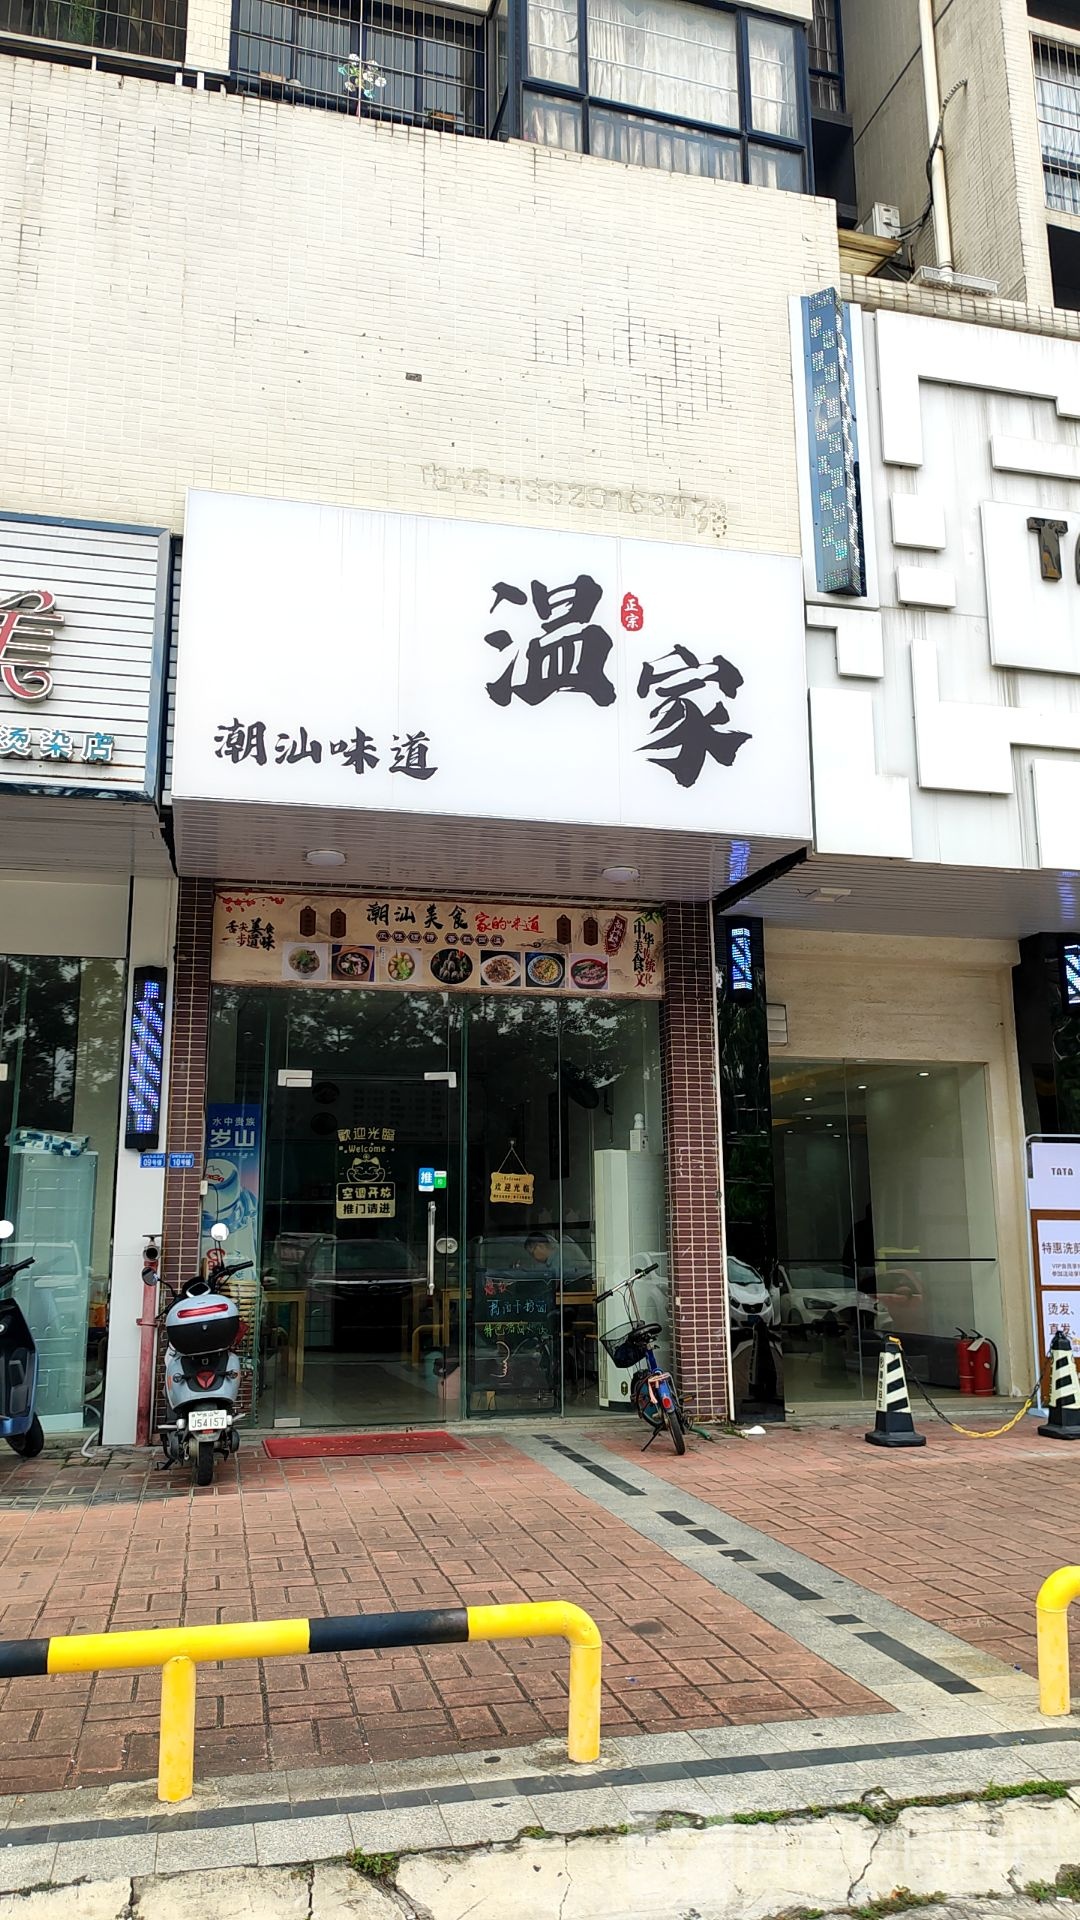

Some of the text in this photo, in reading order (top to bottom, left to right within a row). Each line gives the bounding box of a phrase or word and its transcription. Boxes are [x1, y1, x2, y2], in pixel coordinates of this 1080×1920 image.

[1026, 517, 1080, 585] T
[623, 597, 641, 630] 正宗
[484, 575, 752, 788] 温家
[214, 718, 437, 780] 潮汕味道
[366, 903, 468, 931] 潮汕美食
[474, 911, 545, 934] 家的味道
[225, 917, 275, 936] 舌尖美食
[212, 1116, 256, 1127] 水中贵族
[210, 1128, 255, 1148] 岁山
[348, 1144, 386, 1153] Welcome
[420, 1171, 433, 1184] 推
[1050, 1167, 1074, 1177] TATA
[342, 1186, 392, 1200] 空调开放
[494, 1182, 530, 1193] 欢迎光临
[343, 1202, 391, 1215] 推门请进
[191, 1417, 225, 1429] J54157
